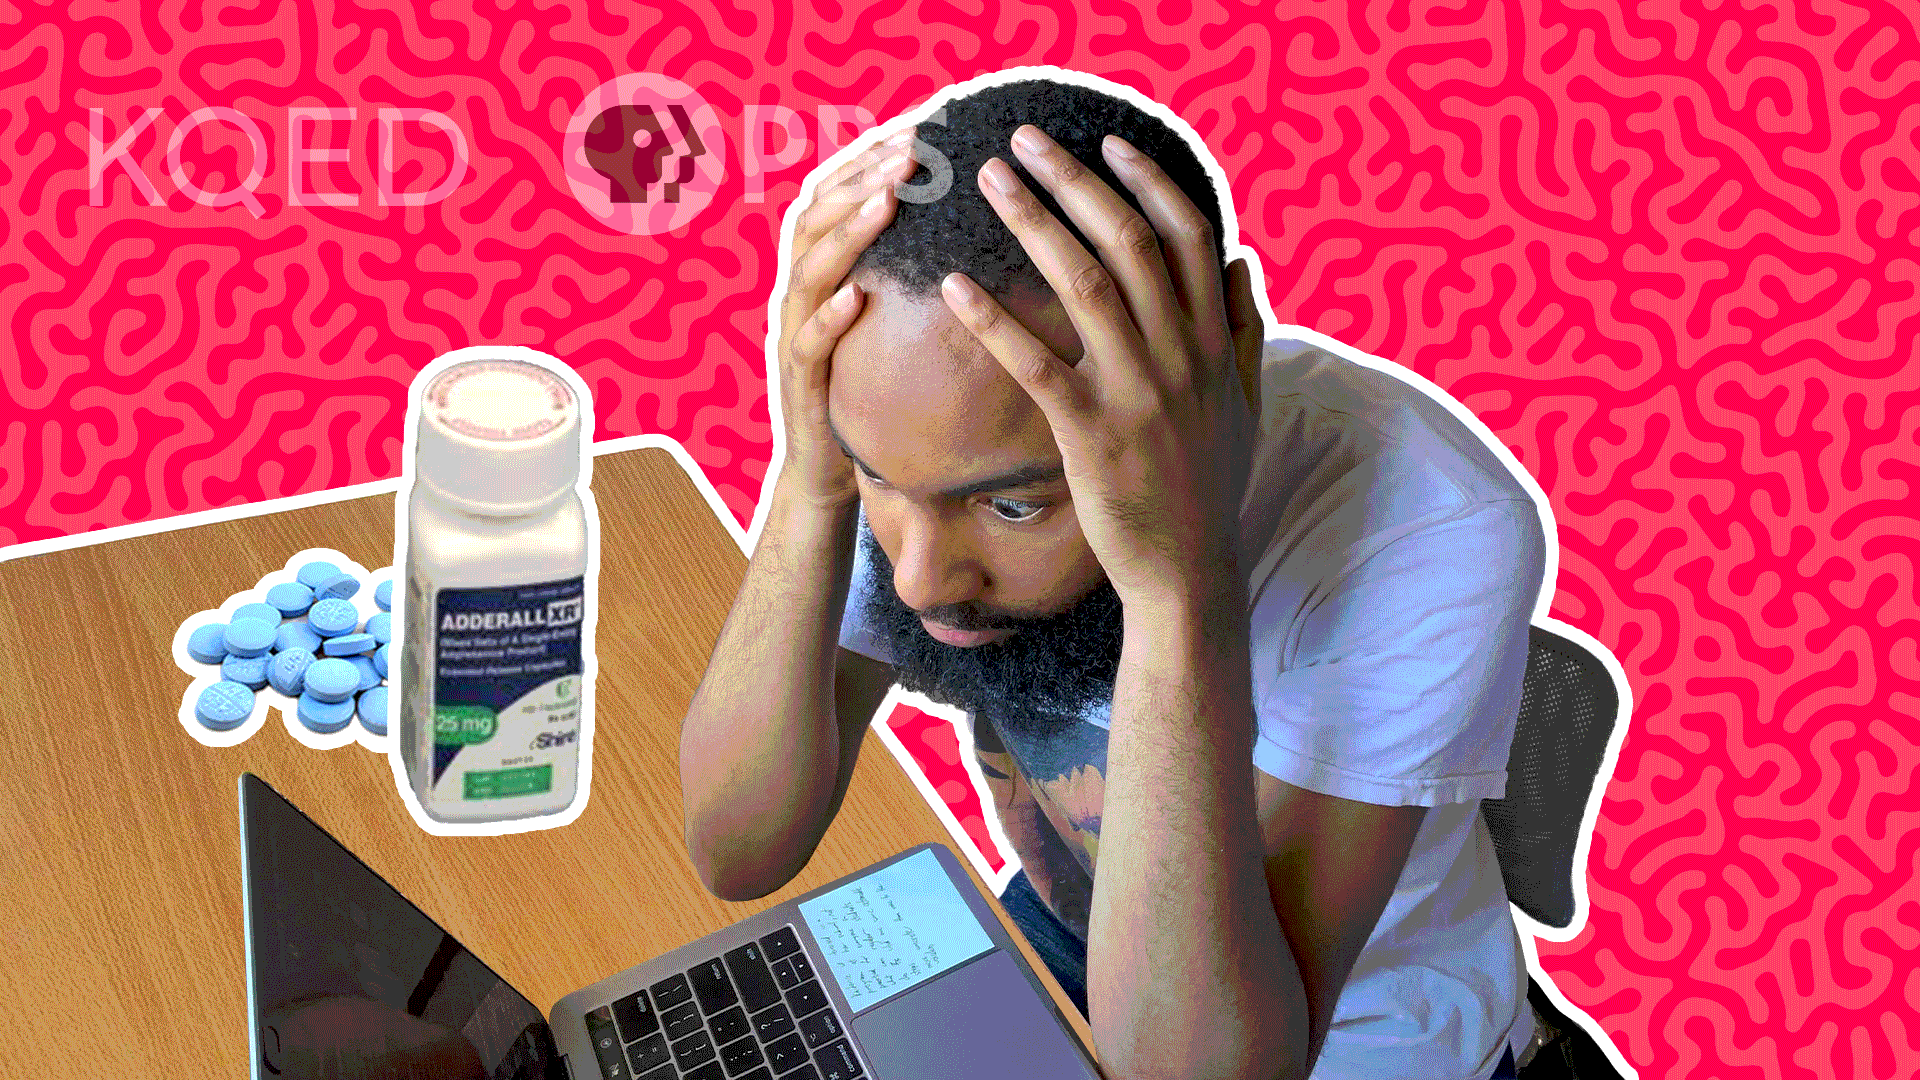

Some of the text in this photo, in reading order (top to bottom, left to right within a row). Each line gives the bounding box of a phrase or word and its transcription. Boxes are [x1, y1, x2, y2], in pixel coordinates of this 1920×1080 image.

[441, 609, 545, 630] ADDERALL
[436, 715, 491, 735] 25 mg
[823, 1015, 836, 1034] option
[836, 1044, 856, 1073] command
